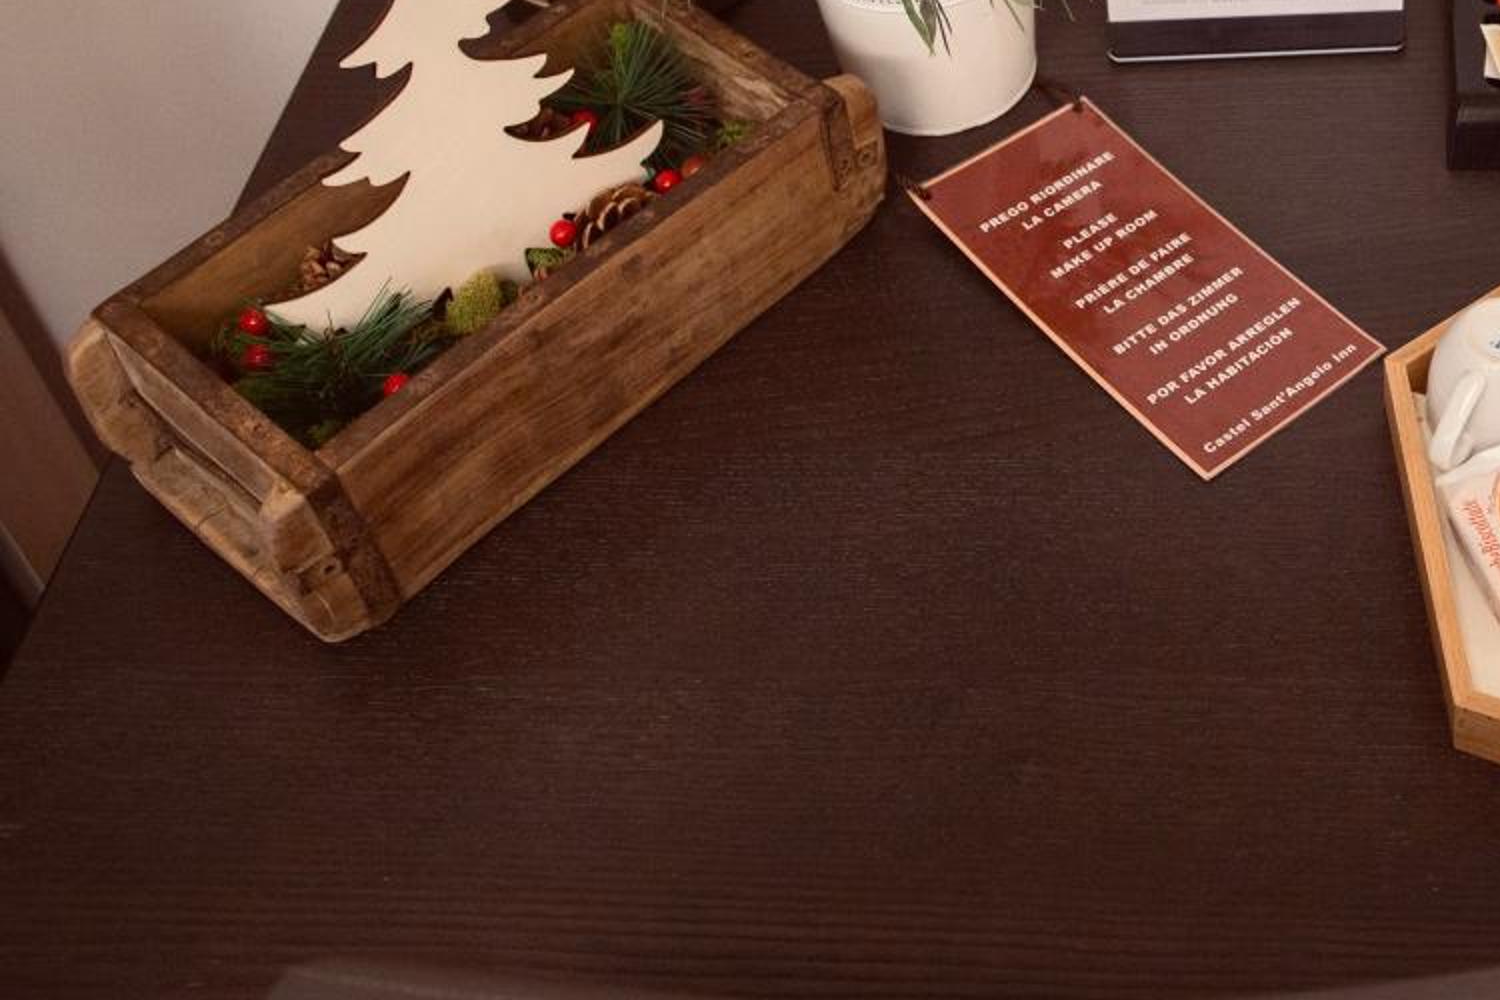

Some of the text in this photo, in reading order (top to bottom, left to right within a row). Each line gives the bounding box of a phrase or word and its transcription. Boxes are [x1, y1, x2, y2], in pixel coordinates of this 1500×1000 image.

[979, 150, 1116, 234] PREGO RIORDINARE
[1022, 179, 1103, 232] LA CAMERA
[1062, 212, 1118, 250] PLEASE
[1050, 209, 1158, 280] MAKE UP ROOM
[1075, 232, 1192, 310] PRIERE DE FAIRE
[1103, 253, 1195, 315] LA CHAMBRE
[1113, 266, 1244, 356] BITTE DAS ZIMMER
[1147, 297, 1302, 406] POR FAVOR ARREGLEN
[1149, 292, 1239, 356] IN ORDNUNG
[1184, 326, 1293, 405] LA HABITACION
[1203, 342, 1357, 454] Castel Sant'Angelo Inn
